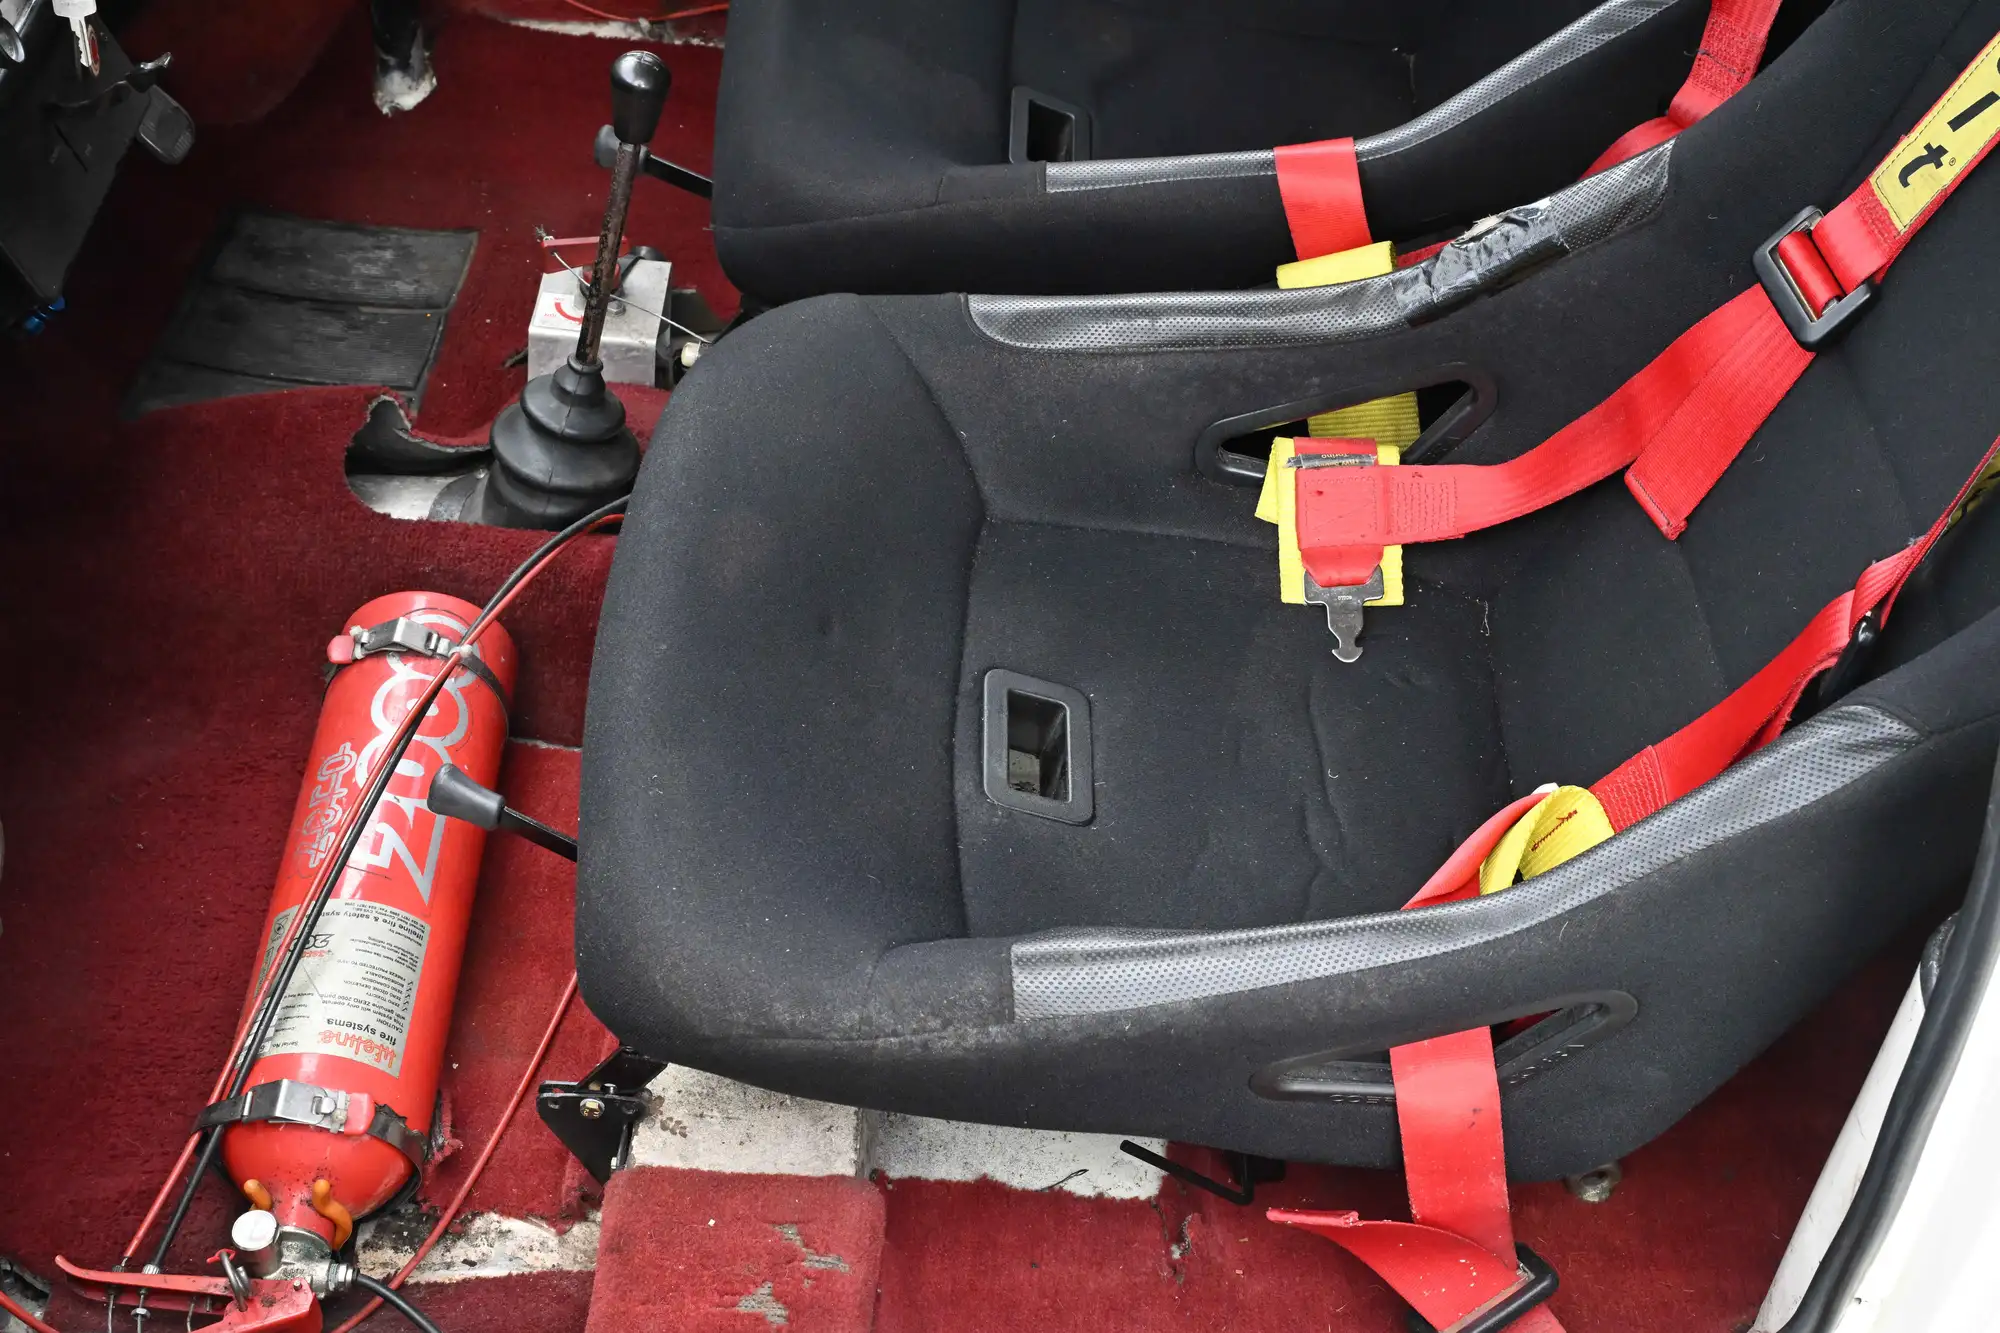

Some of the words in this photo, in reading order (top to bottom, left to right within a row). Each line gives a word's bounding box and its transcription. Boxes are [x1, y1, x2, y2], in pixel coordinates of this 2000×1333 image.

[343, 911, 370, 919] safety
[381, 918, 395, 927] fire
[398, 923, 423, 940] lifeline
[390, 985, 402, 993] ZERO
[389, 992, 401, 1000] ZERO
[352, 997, 370, 1005] ZERO
[387, 999, 399, 1007] ZERO
[371, 1002, 393, 1013] genuine
[372, 1009, 391, 1021] system
[394, 1012, 405, 1020] with
[326, 1017, 376, 1034] systems
[376, 1018, 403, 1033] CAUTION!
[393, 1017, 403, 1026] This
[379, 1031, 396, 1045] fire
